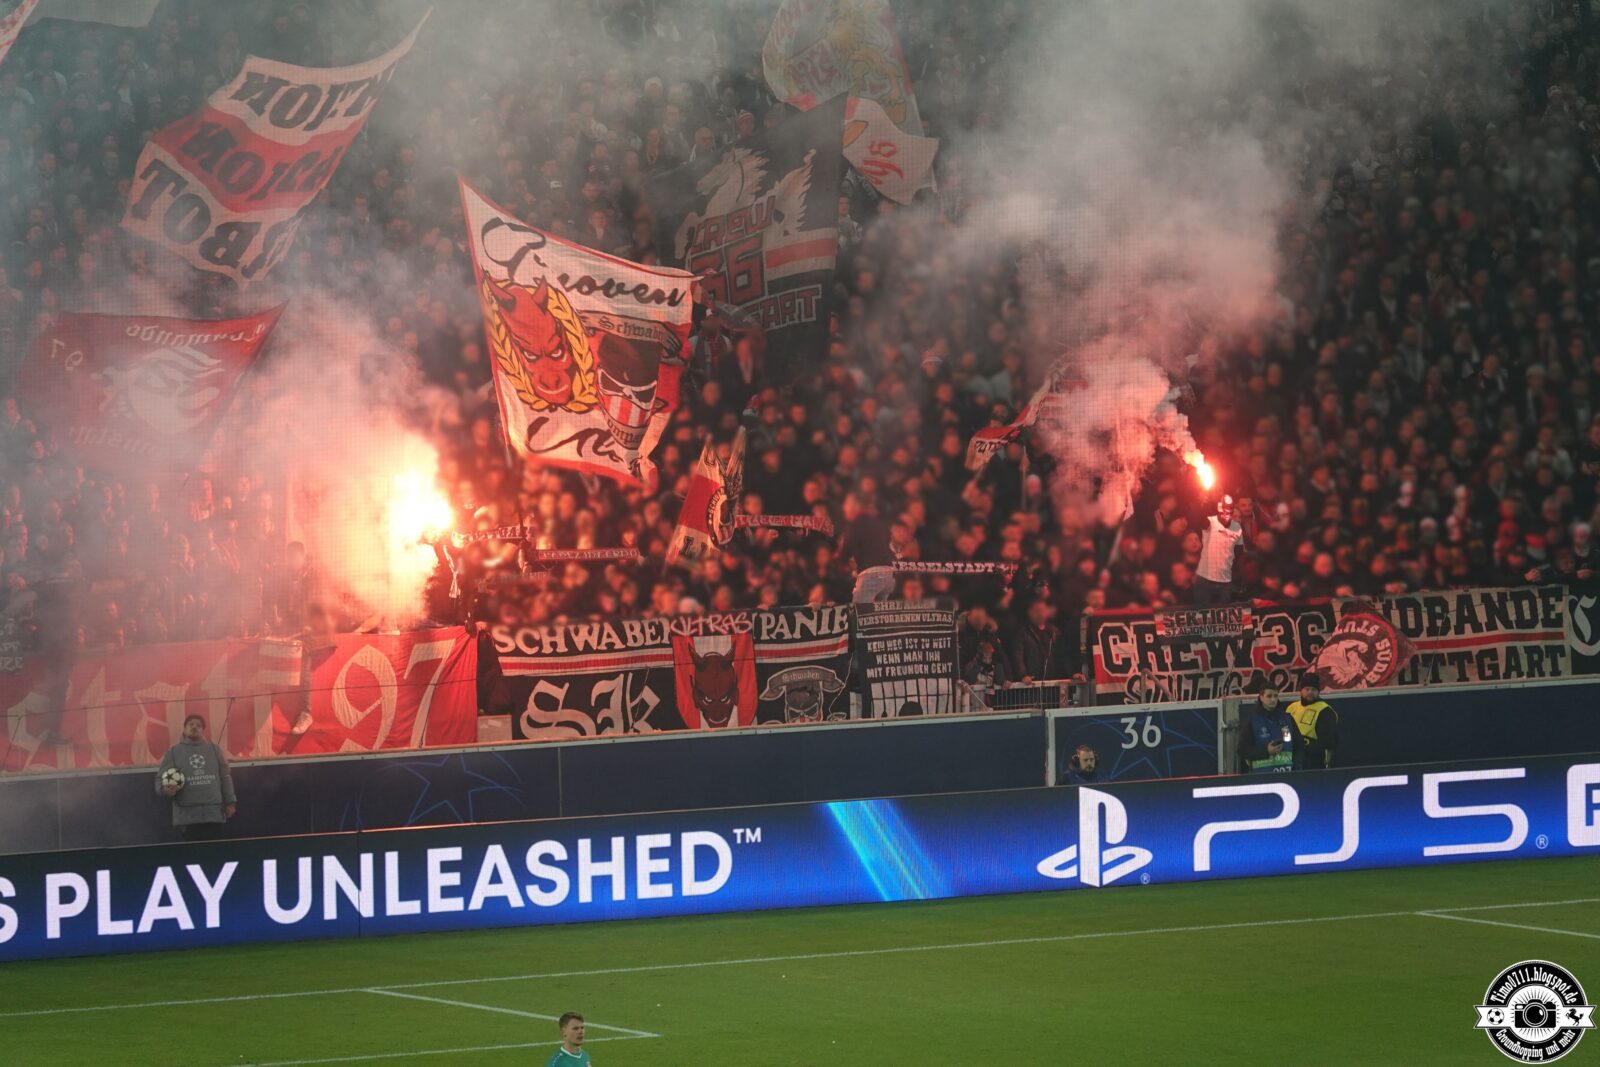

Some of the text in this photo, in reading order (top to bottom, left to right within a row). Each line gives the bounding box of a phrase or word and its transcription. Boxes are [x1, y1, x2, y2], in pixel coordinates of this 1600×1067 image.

[874, 600, 902, 612] EHRE
[922, 612, 953, 623] ULTRAS
[1163, 607, 1243, 628] SEKTION
[671, 612, 752, 637] ULTRAS
[753, 603, 849, 641] PANIE
[867, 640, 886, 653] KEIN
[905, 638, 918, 650] IST
[921, 638, 930, 649] ZU
[932, 637, 952, 649] WEIT
[1261, 611, 1328, 670] 36
[876, 650, 941, 665] WENN MAN IHN
[866, 662, 953, 679] MIT FREUNDEN GEHT
[332, 637, 457, 751] 97
[1120, 715, 1162, 750] 36
[46, 861, 239, 939] PLAY
